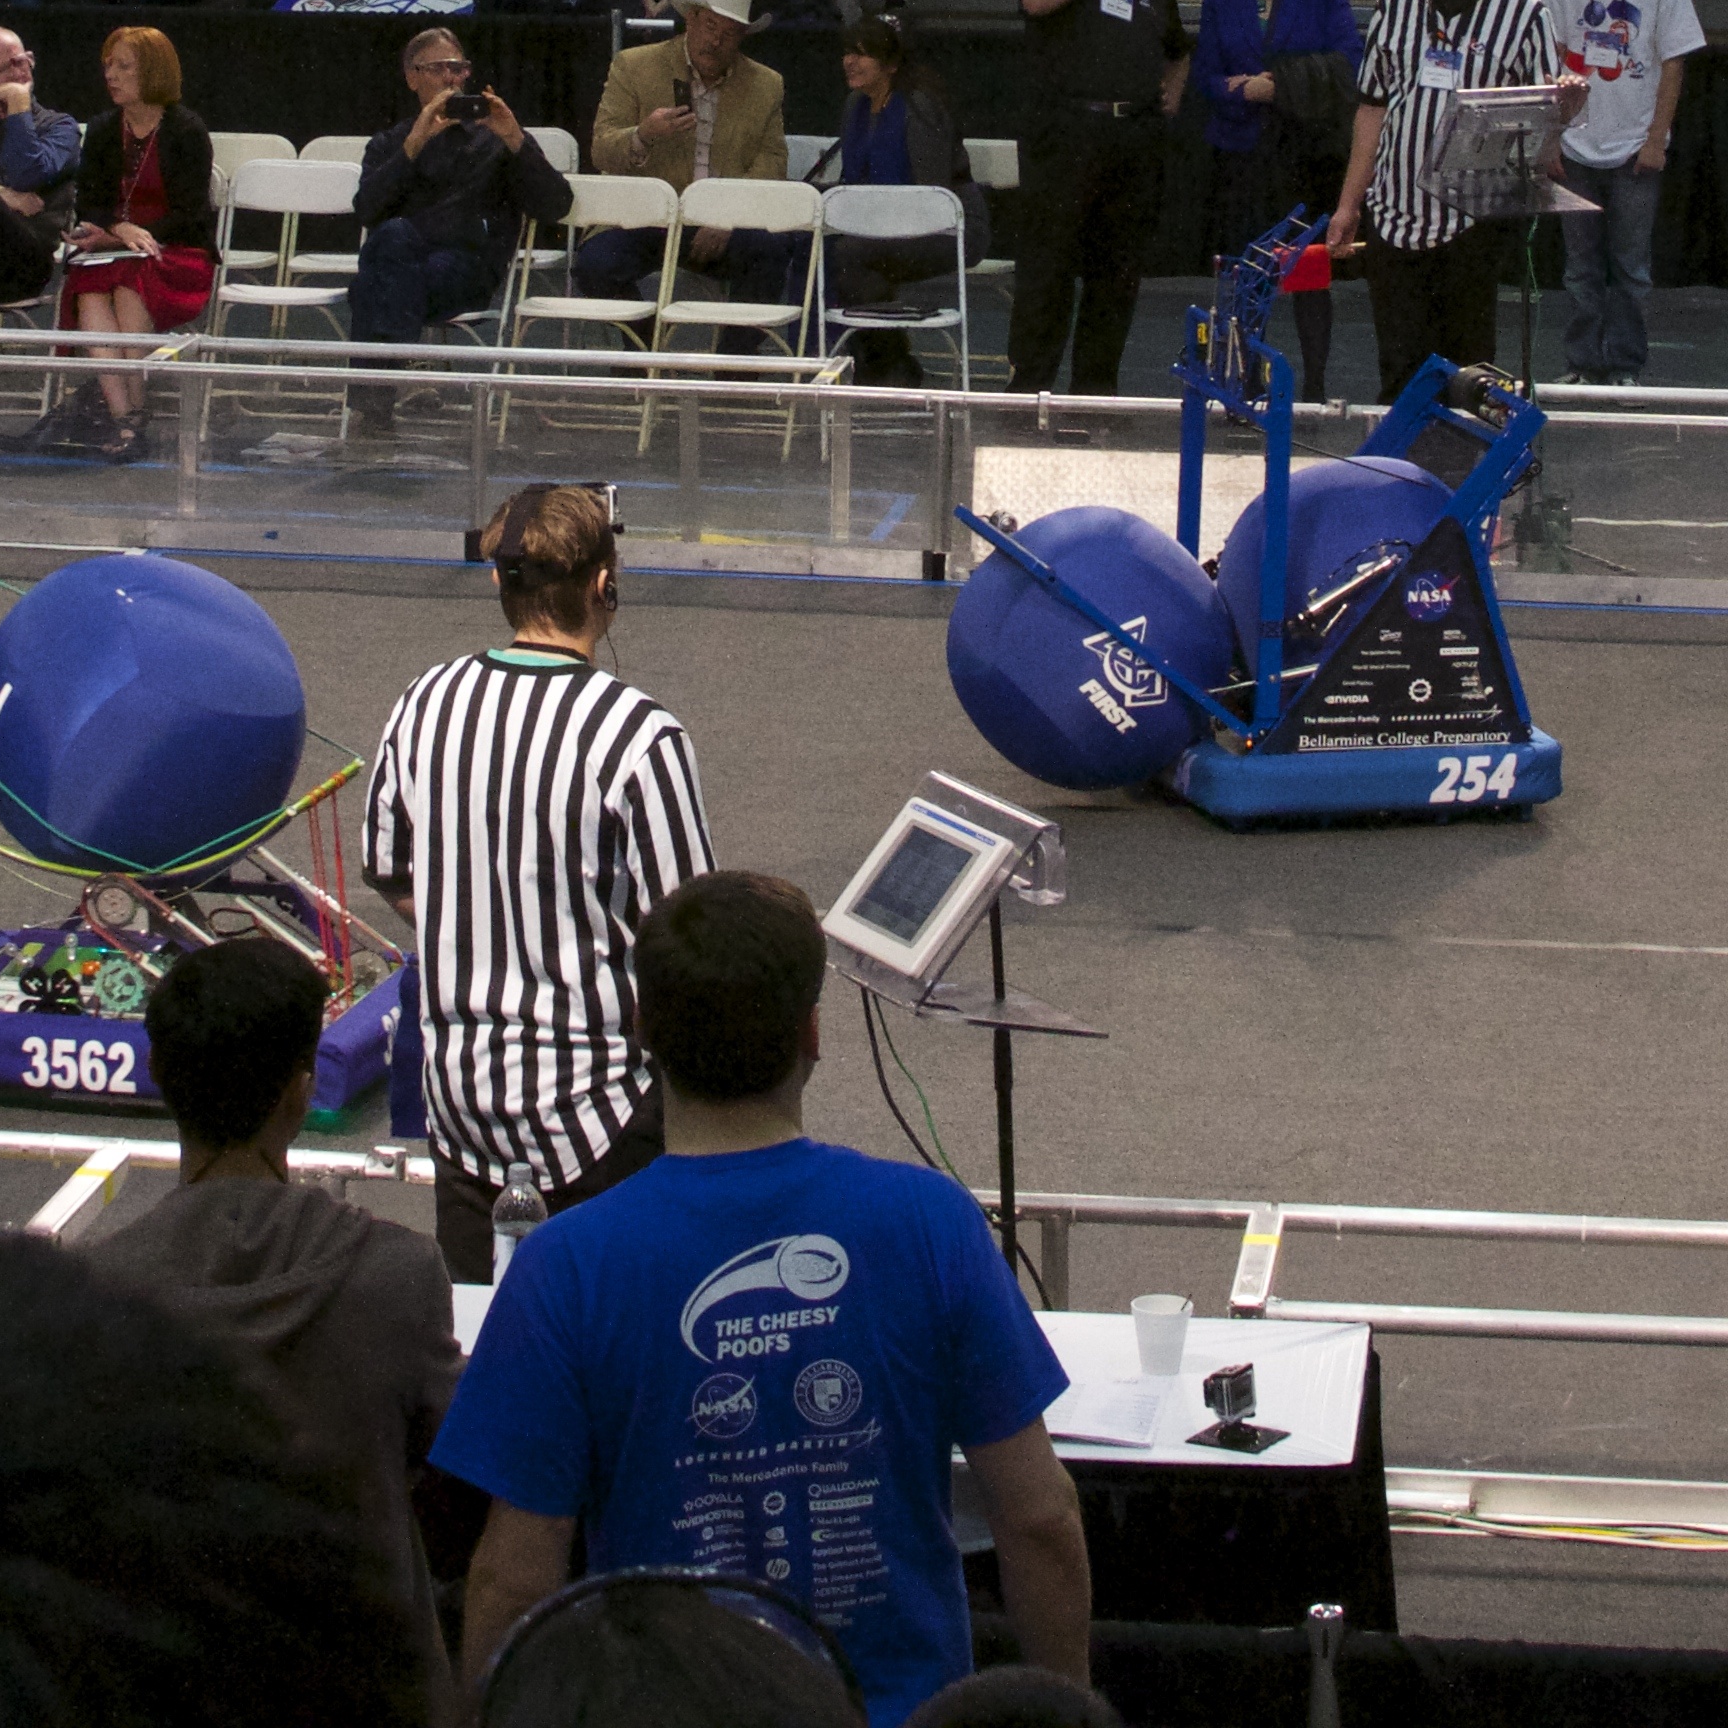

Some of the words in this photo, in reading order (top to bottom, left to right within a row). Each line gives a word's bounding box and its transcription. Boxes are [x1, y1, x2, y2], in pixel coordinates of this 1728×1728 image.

[1407, 589, 1452, 603] NASA
[1078, 678, 1137, 734] FIRST
[1299, 733, 1373, 748] Bellarmine
[1377, 731, 1430, 747] College
[1432, 729, 1511, 745] Preparatory
[1429, 753, 1518, 804] 254
[20, 1036, 138, 1095] 3562
[715, 1318, 754, 1338] THE
[758, 1305, 841, 1332] CHEESY
[716, 1332, 791, 1360] POOFS
[698, 1394, 753, 1417] NASA
[708, 1472, 729, 1484] The
[812, 1460, 850, 1473] Family
